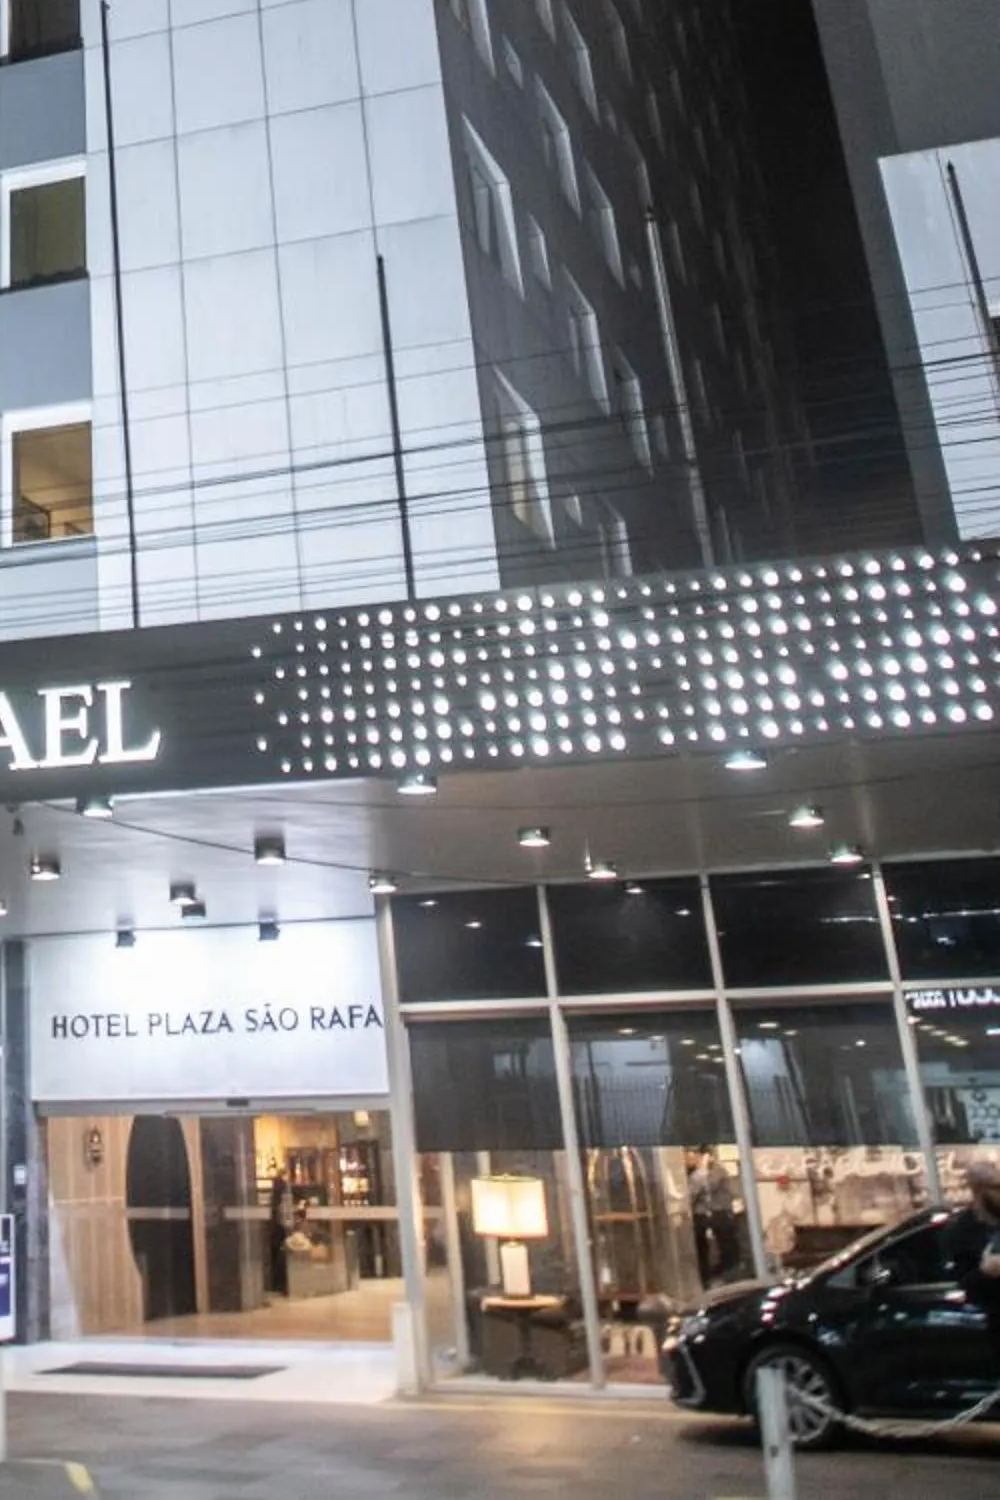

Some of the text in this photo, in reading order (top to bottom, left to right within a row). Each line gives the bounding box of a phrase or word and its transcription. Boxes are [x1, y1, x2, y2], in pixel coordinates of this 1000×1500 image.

[51, 1003, 383, 1039] HOTEL PLAZA SÃO RAFA
